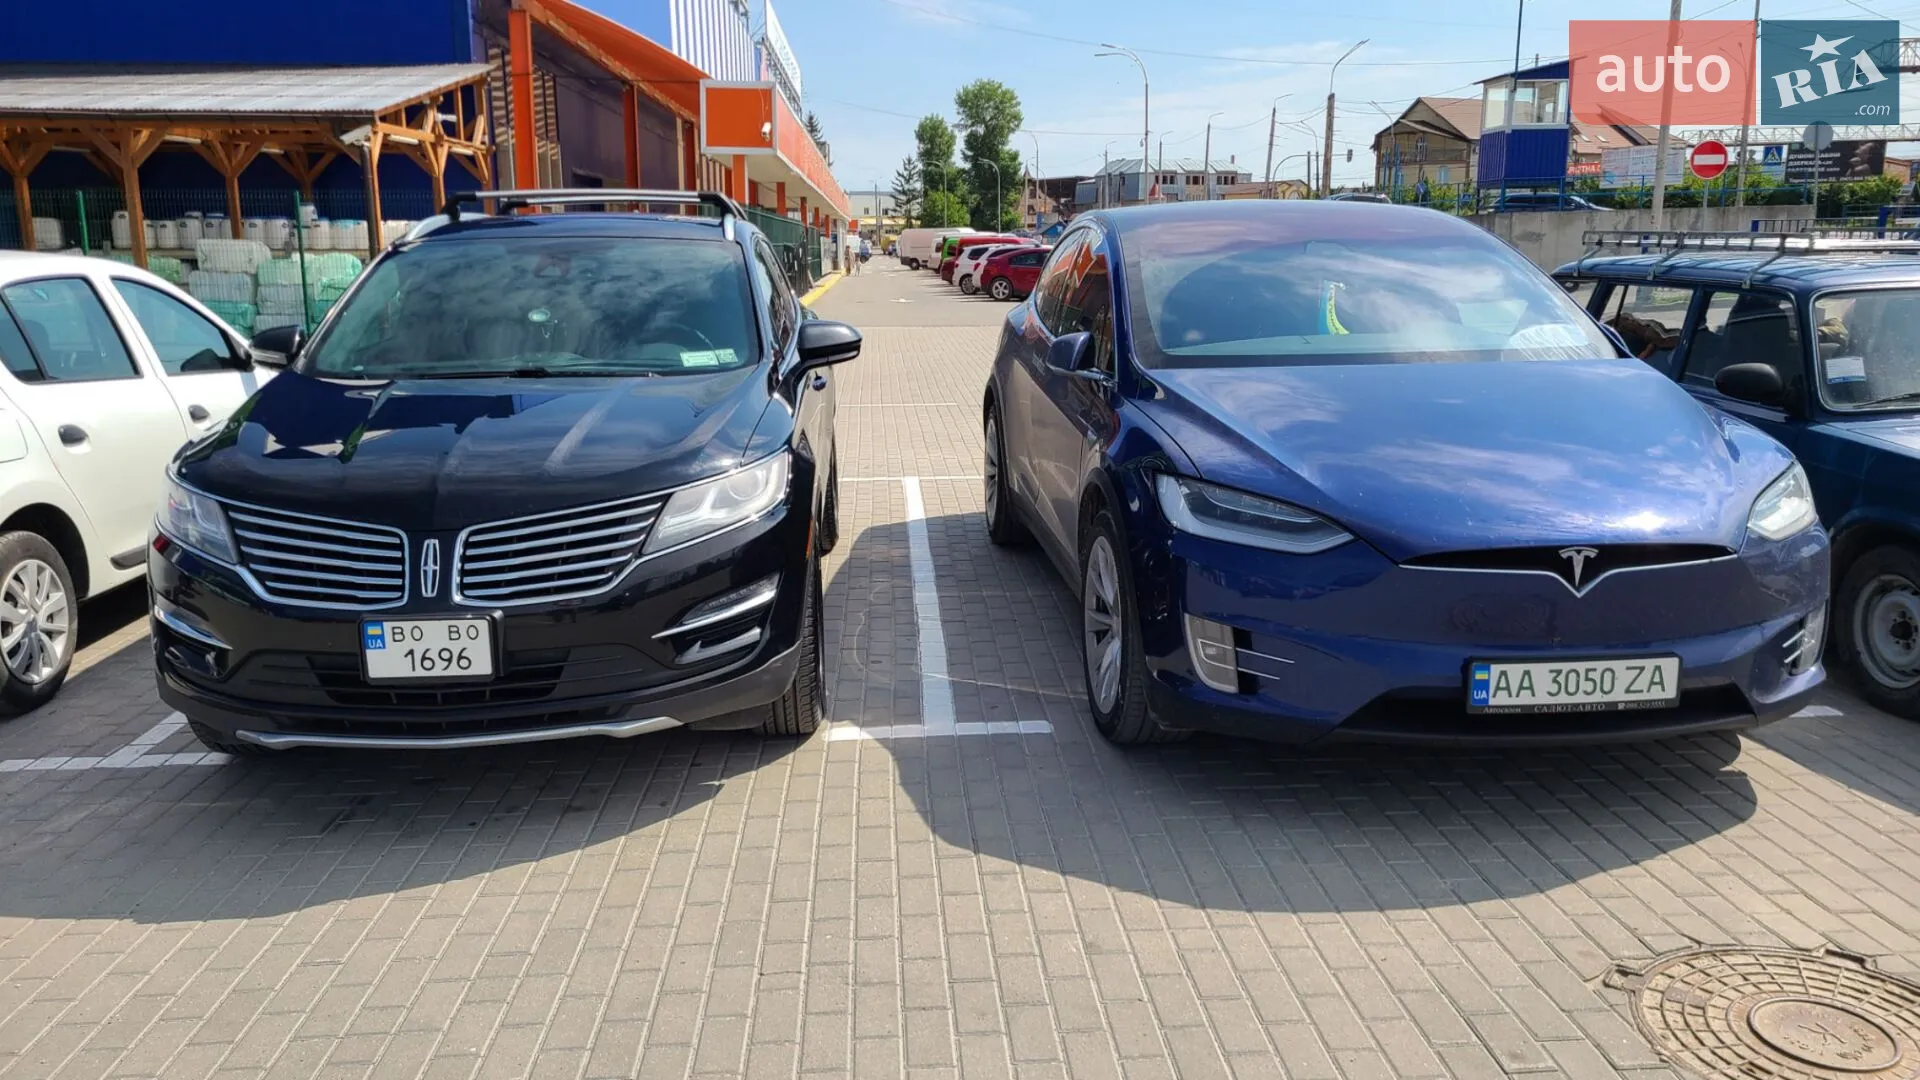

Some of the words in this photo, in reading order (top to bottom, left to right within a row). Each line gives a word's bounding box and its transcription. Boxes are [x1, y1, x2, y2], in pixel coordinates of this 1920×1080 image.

[391, 625, 424, 642] BO
[447, 624, 479, 641] BO
[368, 639, 384, 649] UA
[404, 647, 472, 672] 1696
[1492, 669, 1536, 698] AA
[1546, 667, 1616, 697] 3050
[1624, 664, 1666, 694] ZA
[1473, 690, 1488, 700] UA
